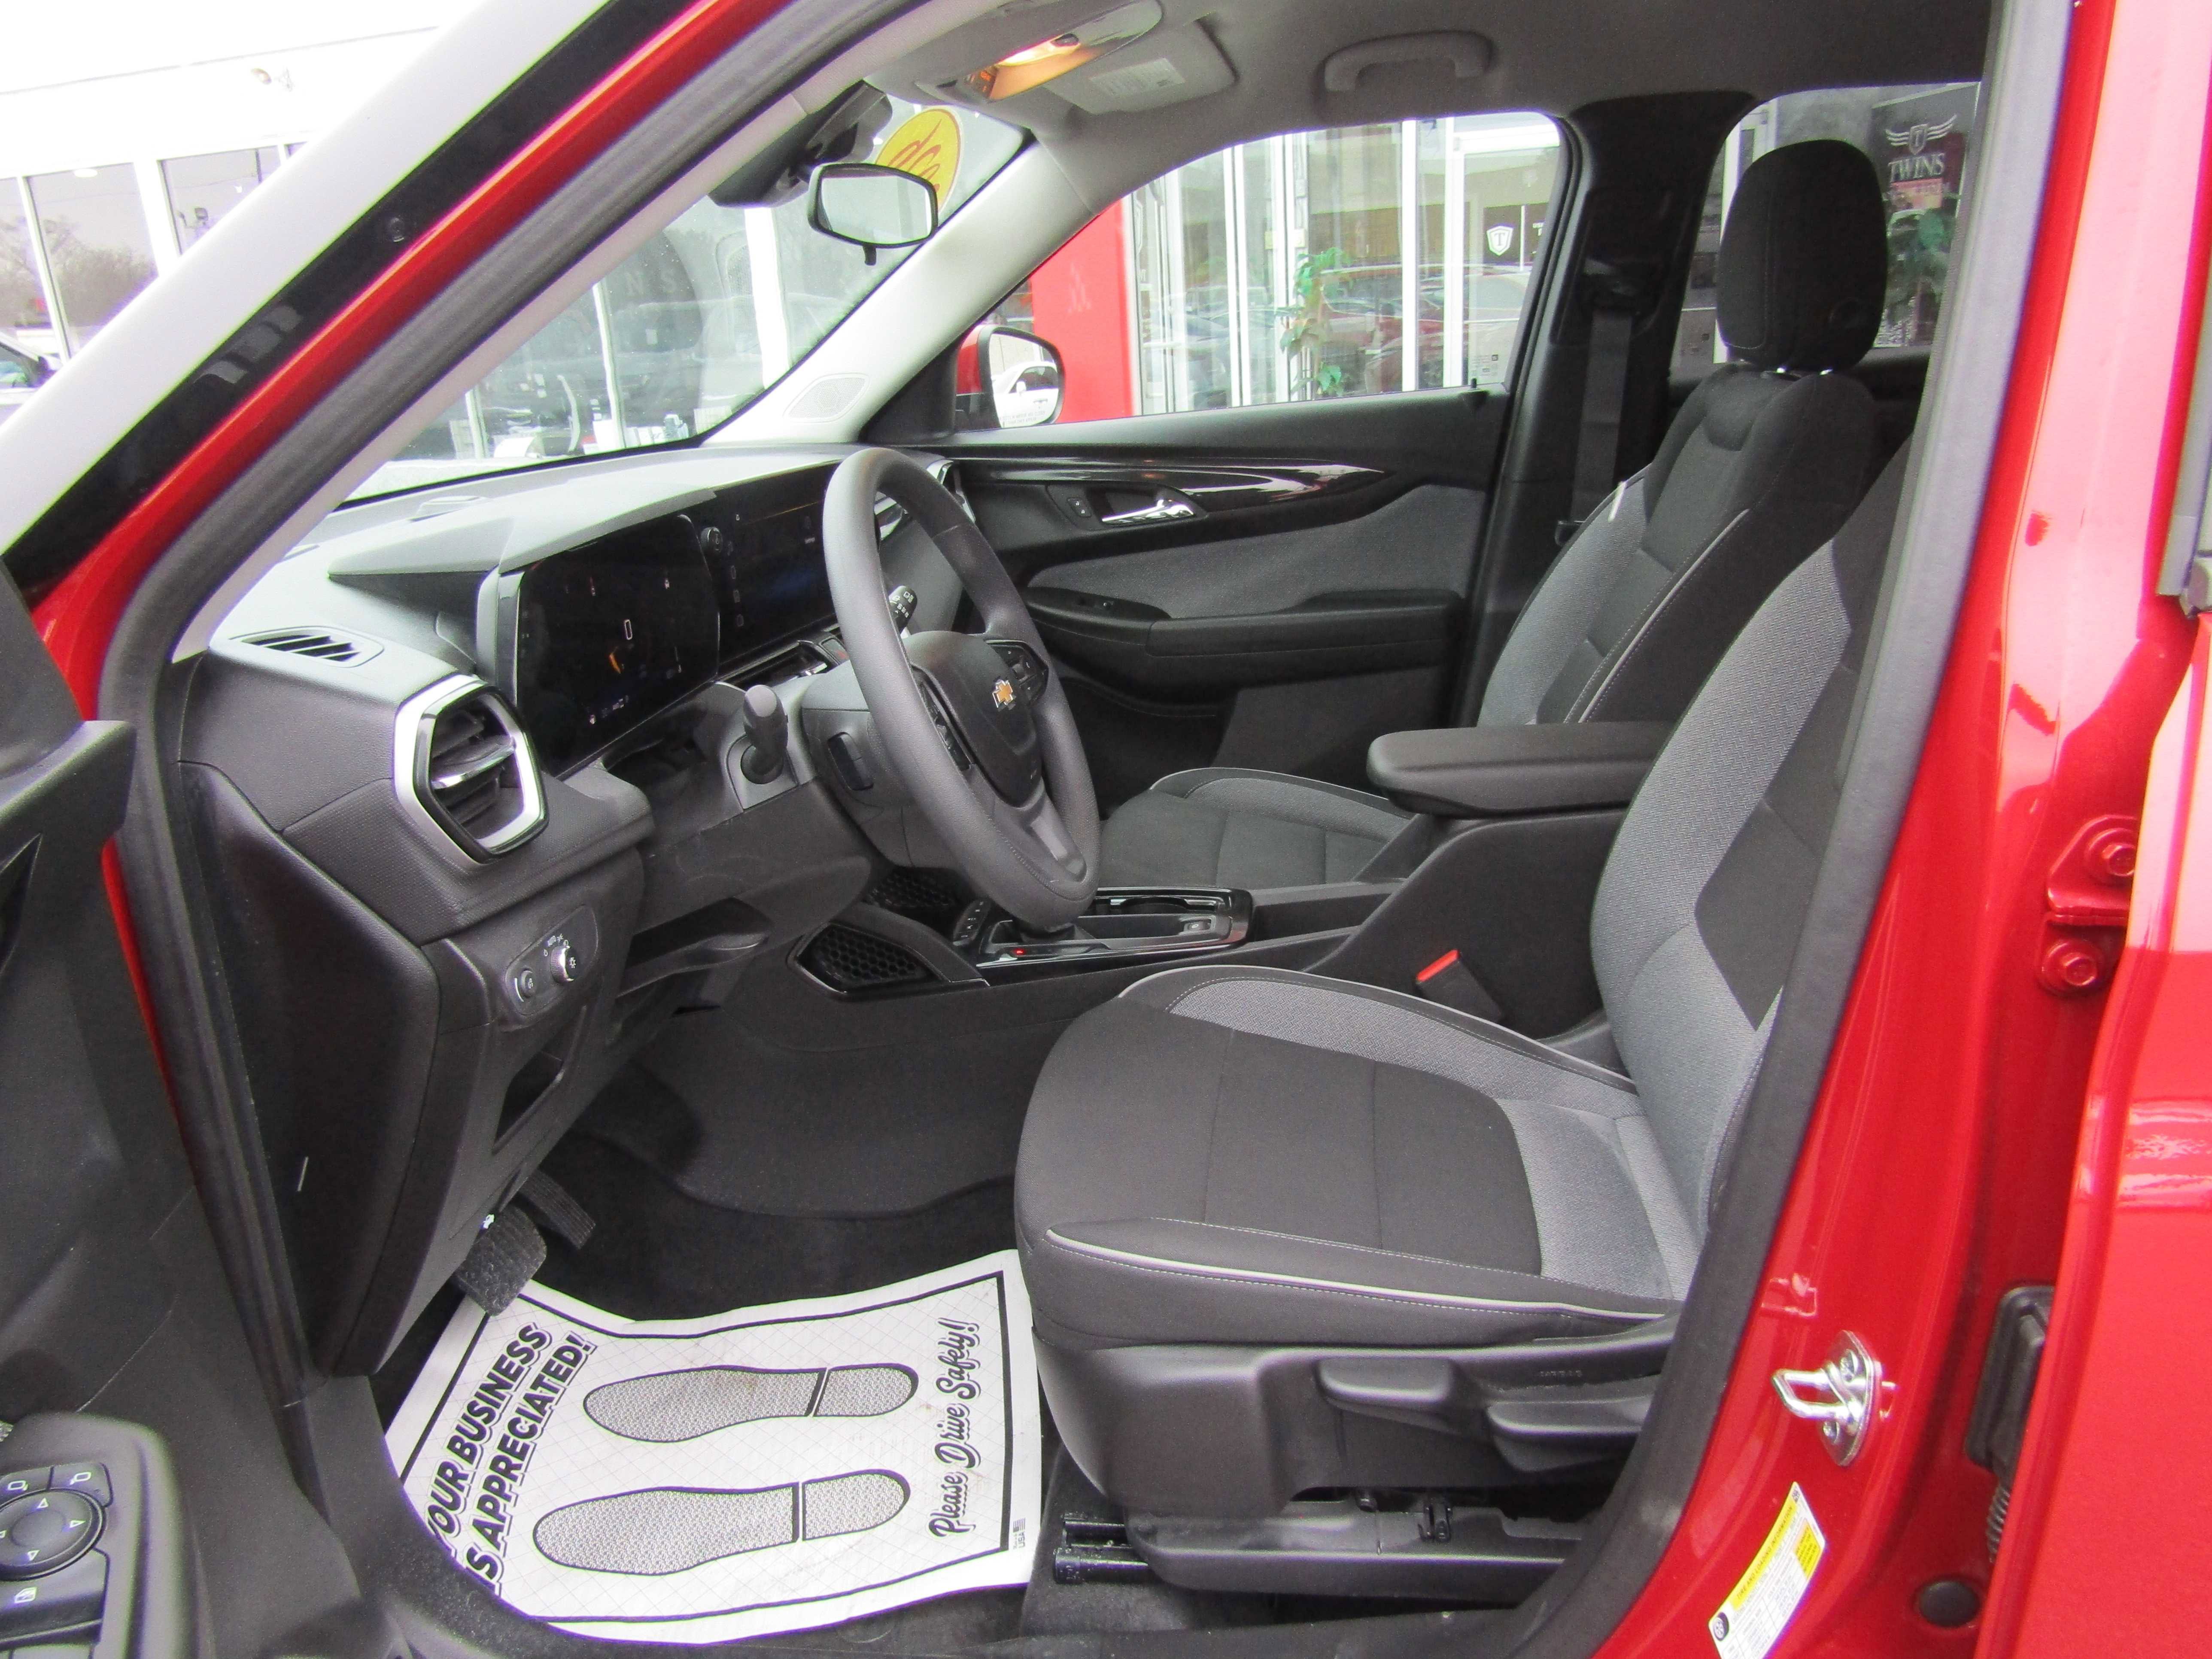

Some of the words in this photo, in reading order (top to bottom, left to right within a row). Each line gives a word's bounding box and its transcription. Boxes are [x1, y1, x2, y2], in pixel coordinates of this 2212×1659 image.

[1888, 153, 1945, 182] TWINS
[1494, 232, 1506, 246] T
[447, 1324, 550, 1468] BUSINESS
[936, 1320, 978, 1400] Safely!
[472, 1334, 594, 1551] APPRECIATED!
[935, 1403, 978, 1469] Drive
[929, 1473, 973, 1537] Please
[1747, 1573, 1755, 1585] AND
[1771, 1506, 1793, 1546] INFORMATION
